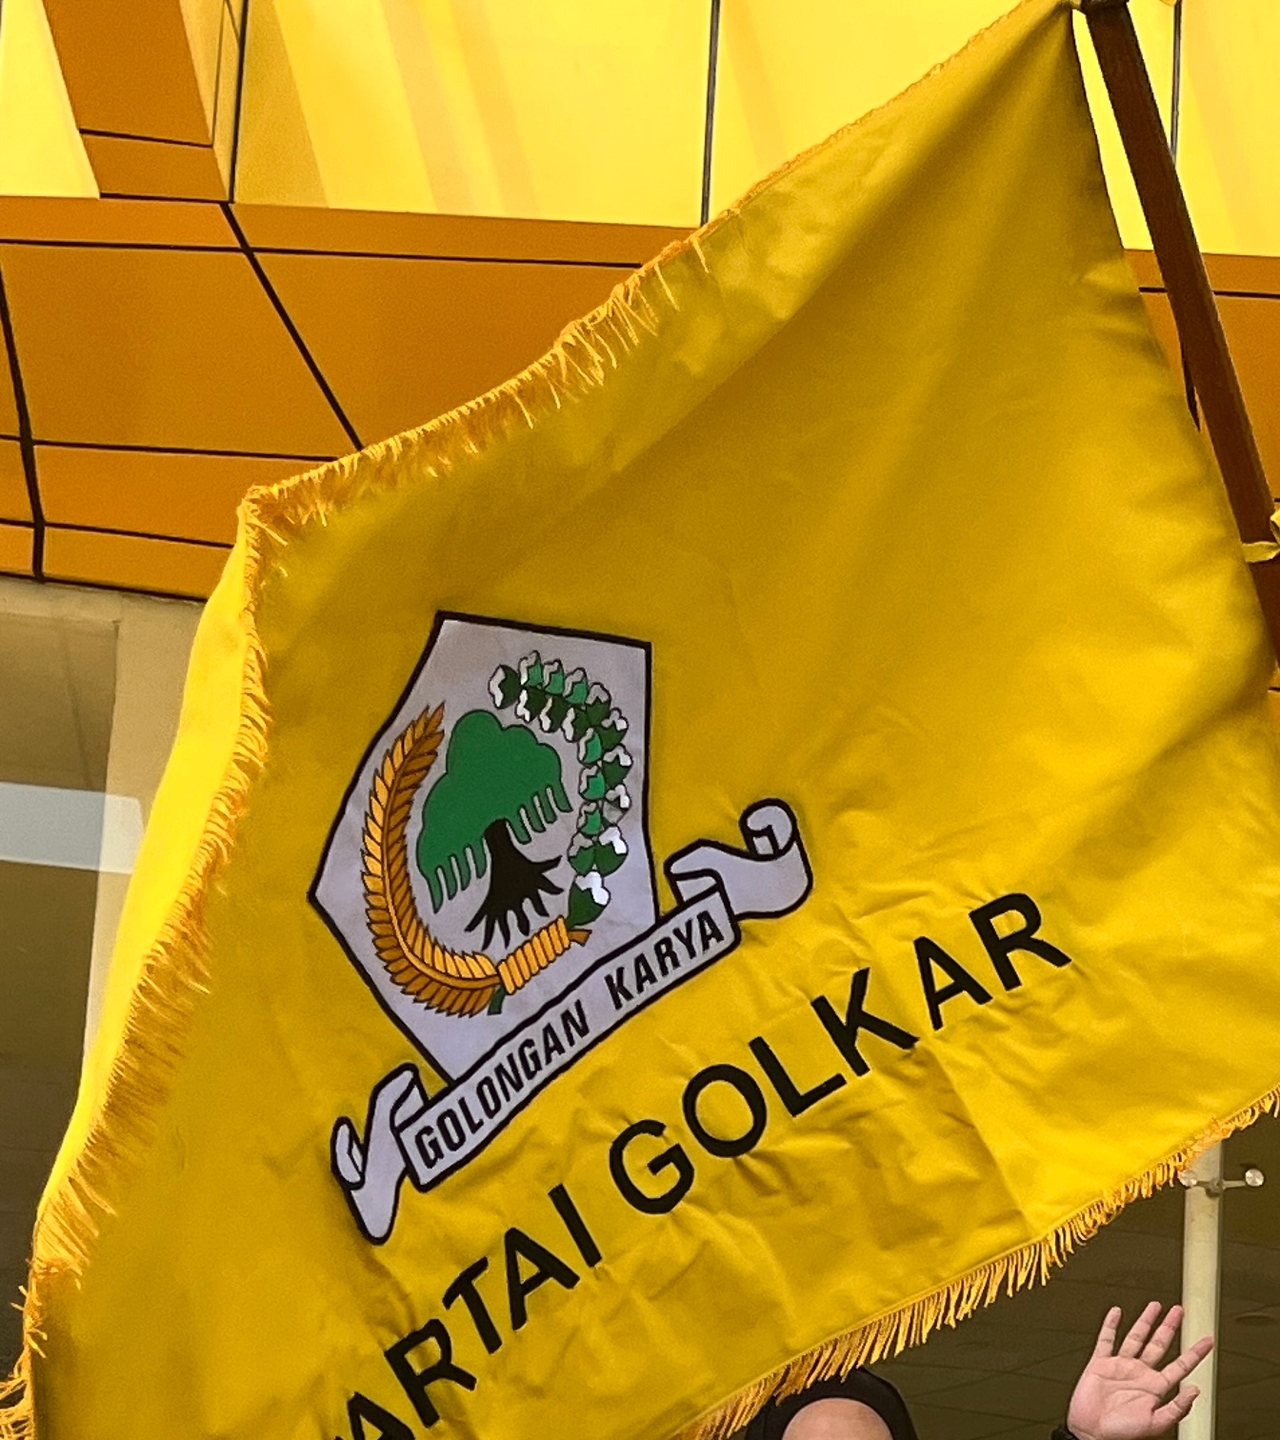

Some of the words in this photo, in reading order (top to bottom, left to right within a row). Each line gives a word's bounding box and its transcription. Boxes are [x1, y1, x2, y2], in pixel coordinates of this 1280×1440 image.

[414, 1000, 590, 1170] GOLONGAN
[604, 910, 726, 1011] KARYA
[609, 892, 1072, 1215] GOLKAR
